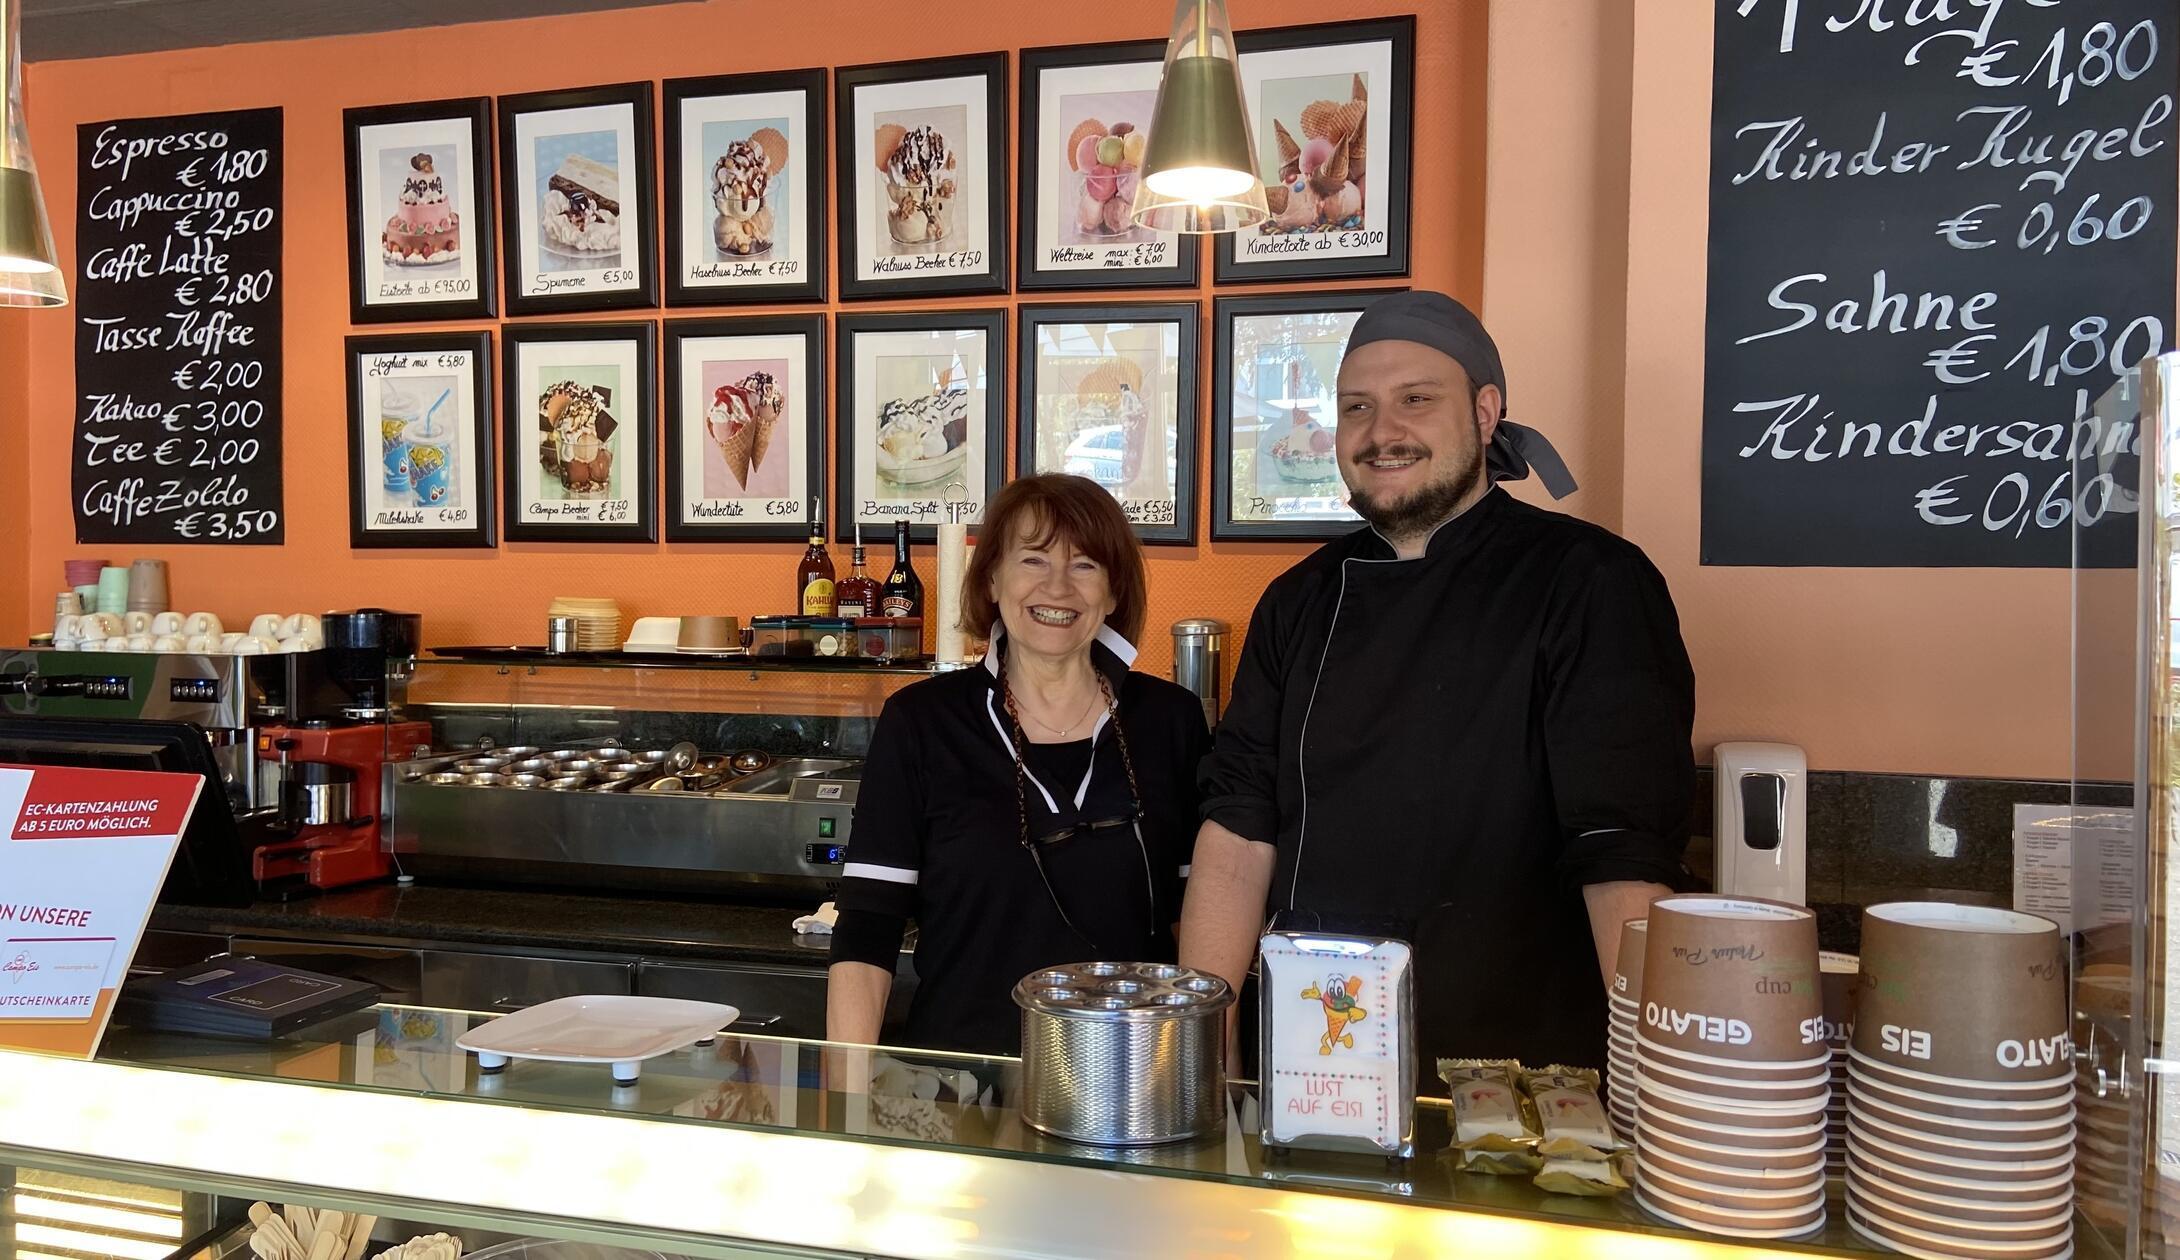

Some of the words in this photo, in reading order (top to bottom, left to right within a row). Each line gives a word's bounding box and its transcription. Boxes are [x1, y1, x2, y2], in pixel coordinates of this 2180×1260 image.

[91, 126, 229, 181] Espresso
[1732, 111, 1951, 185] Kinder
[1956, 94, 2172, 196] Kugel
[89, 186, 240, 232] Cappuccino
[1315, 233, 1332, 250] ab
[86, 243, 154, 284] Caffe
[158, 234, 230, 276] Latte
[872, 256, 912, 274] Walnuss
[418, 281, 430, 294] ab
[532, 274, 586, 294] Spumone
[1734, 269, 1998, 345] Sahne
[83, 316, 162, 354] Tasse
[165, 309, 255, 357] Kaffee
[82, 393, 162, 424] Kakao
[83, 432, 147, 467] Tee
[529, 502, 559, 521] Campo
[860, 500, 910, 516] Banana
[910, 500, 939, 522] Split
[25, 799, 159, 816] EC-KARTENZAHLUNG
[18, 821, 36, 833] AB
[38, 820, 46, 832] 5
[48, 818, 85, 832] EURO
[86, 815, 152, 831] MÖGLICH.
[20, 905, 92, 928] UNSERE
[1646, 1001, 1753, 1046] GELATO
[1799, 1014, 1825, 1045] EIS
[1881, 1024, 1932, 1060] EIS
[1306, 1080, 1344, 1098] LUST
[1288, 1098, 1322, 1117] AUF
